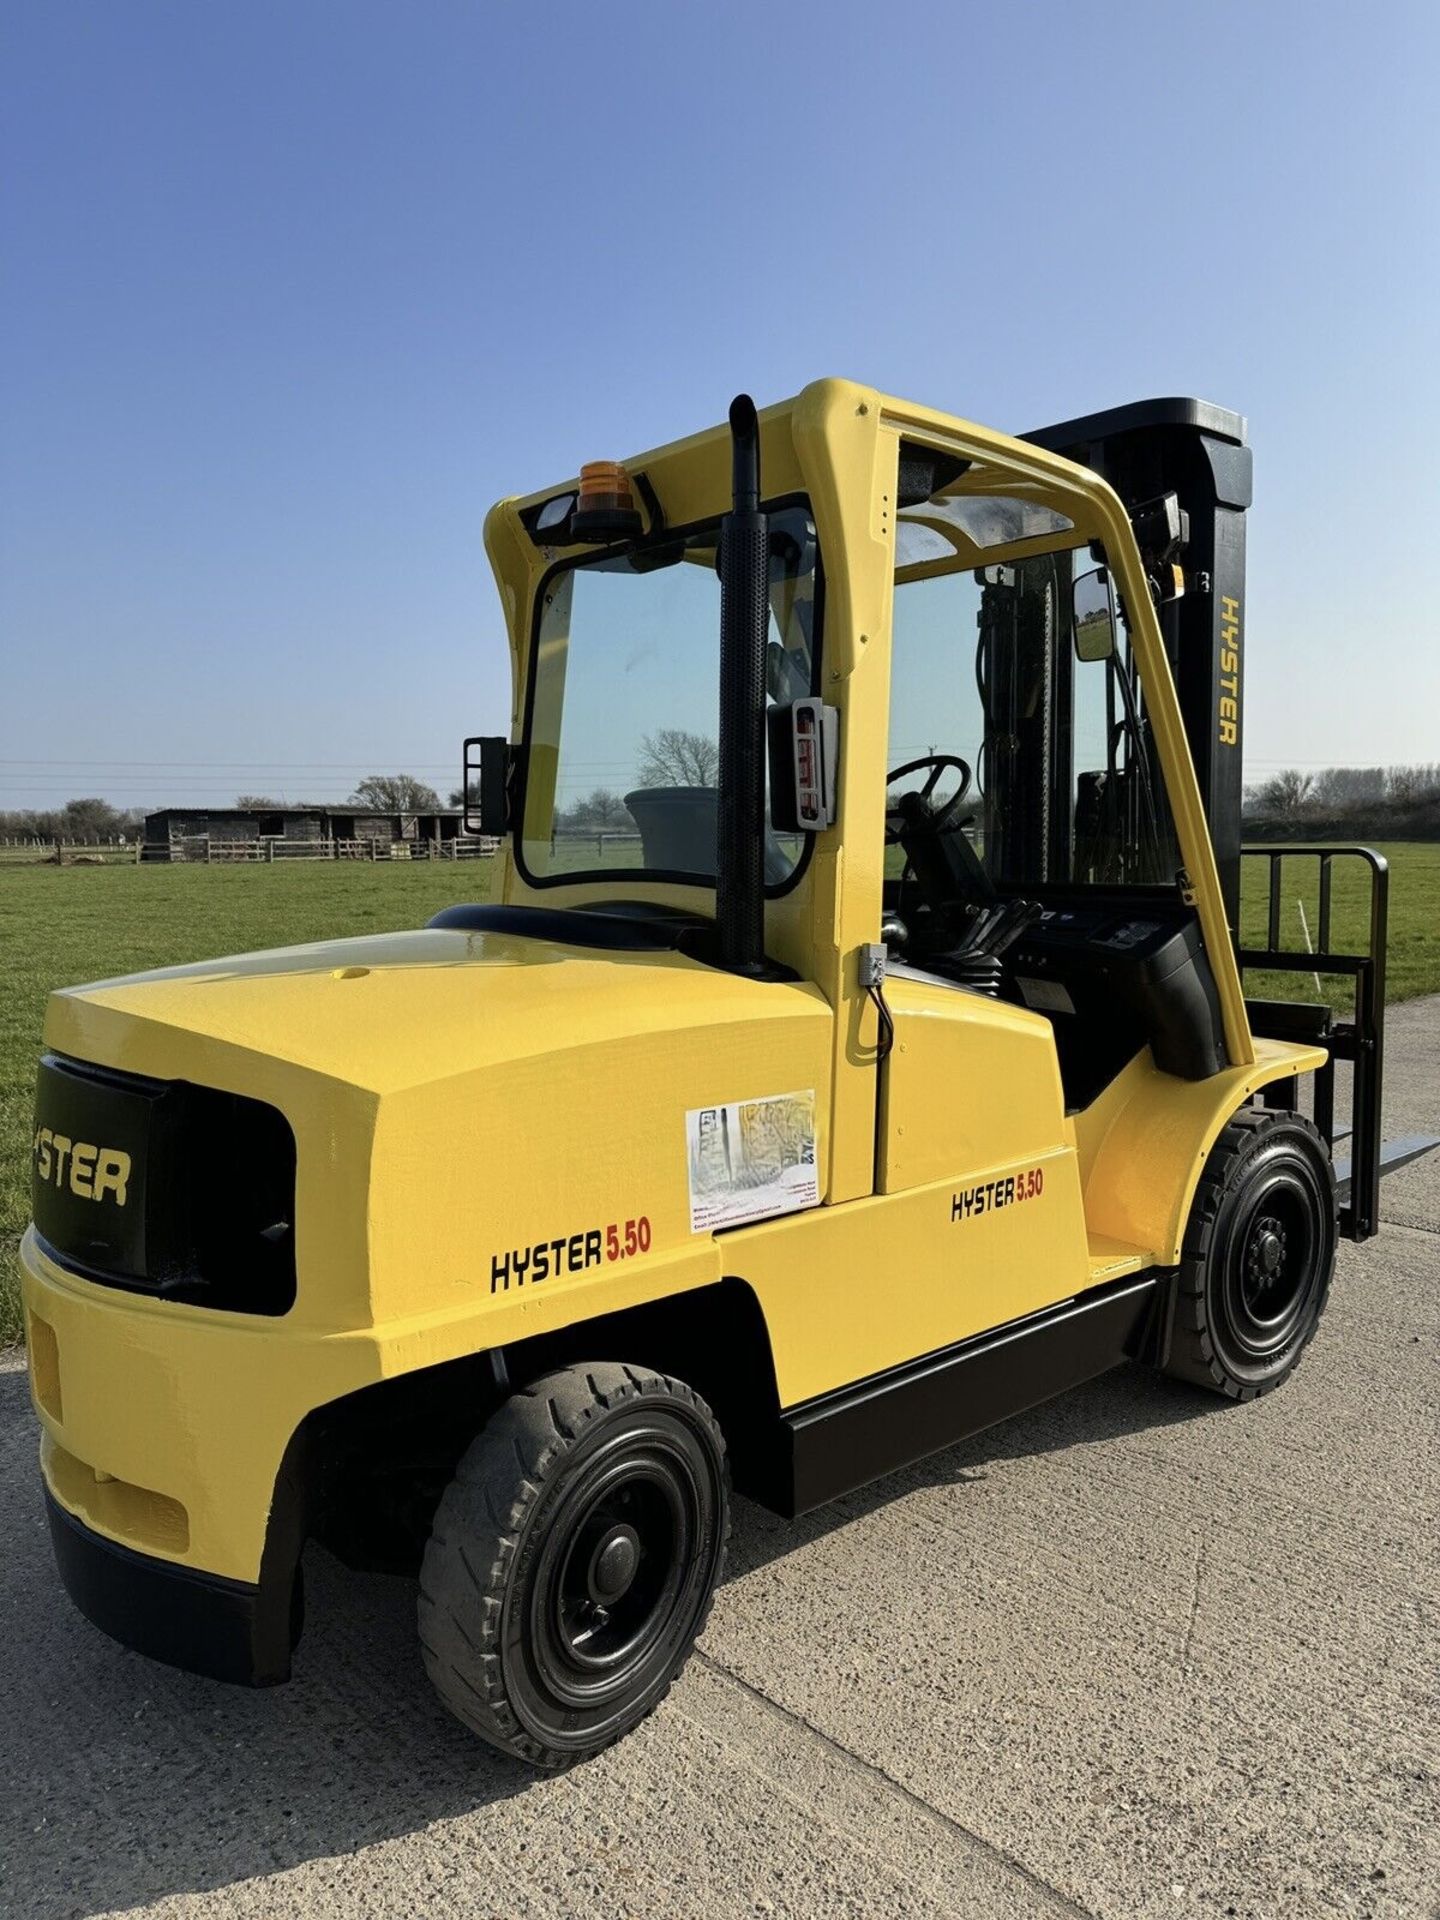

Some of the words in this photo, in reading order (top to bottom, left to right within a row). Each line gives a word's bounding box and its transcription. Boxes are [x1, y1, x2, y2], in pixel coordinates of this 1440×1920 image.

[1219, 595, 1239, 745] HYSTER
[951, 1177, 1015, 1222] HYSTER
[1017, 1168, 1043, 1201] 5.50
[491, 1229, 602, 1294] HYSTER
[606, 1216, 651, 1262] 5.50
